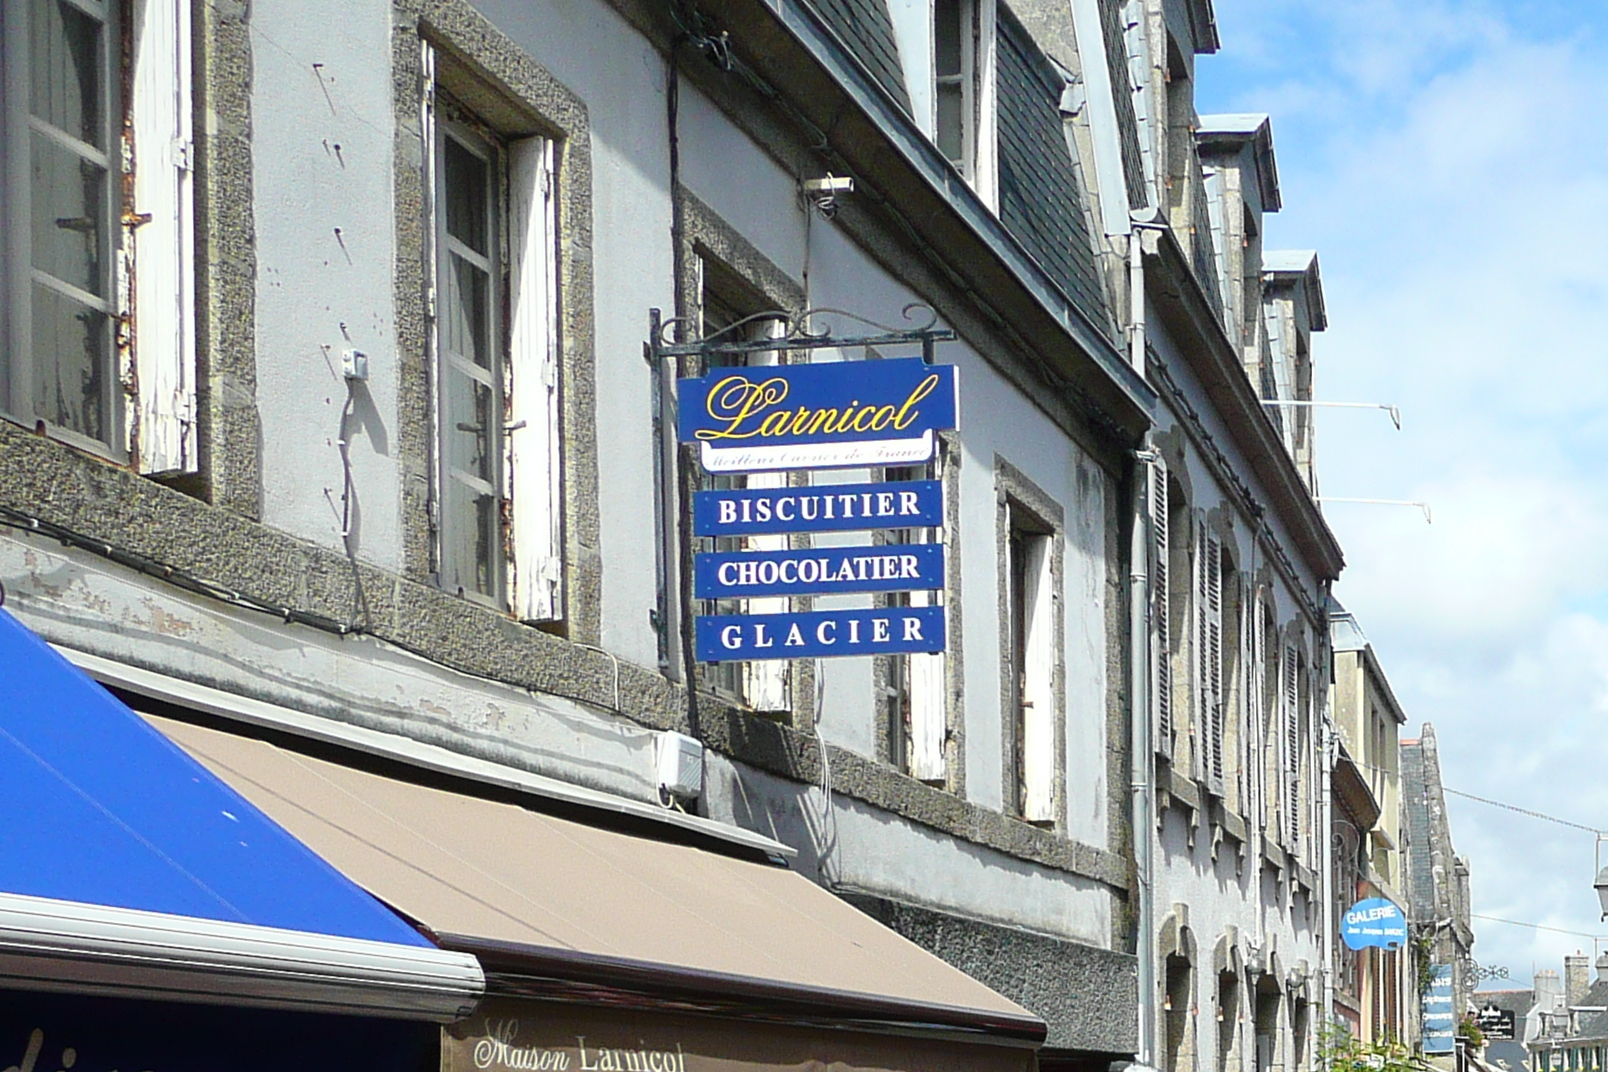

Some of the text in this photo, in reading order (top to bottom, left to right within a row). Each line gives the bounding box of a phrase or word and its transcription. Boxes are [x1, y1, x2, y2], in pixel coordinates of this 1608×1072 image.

[695, 374, 939, 440] Larnicol
[718, 491, 921, 524] BISCUITIER
[718, 554, 921, 586] CHOCOLATIER
[721, 616, 924, 650] GLACIER
[1346, 905, 1396, 925] GALERIE
[474, 1017, 570, 1071] Maison
